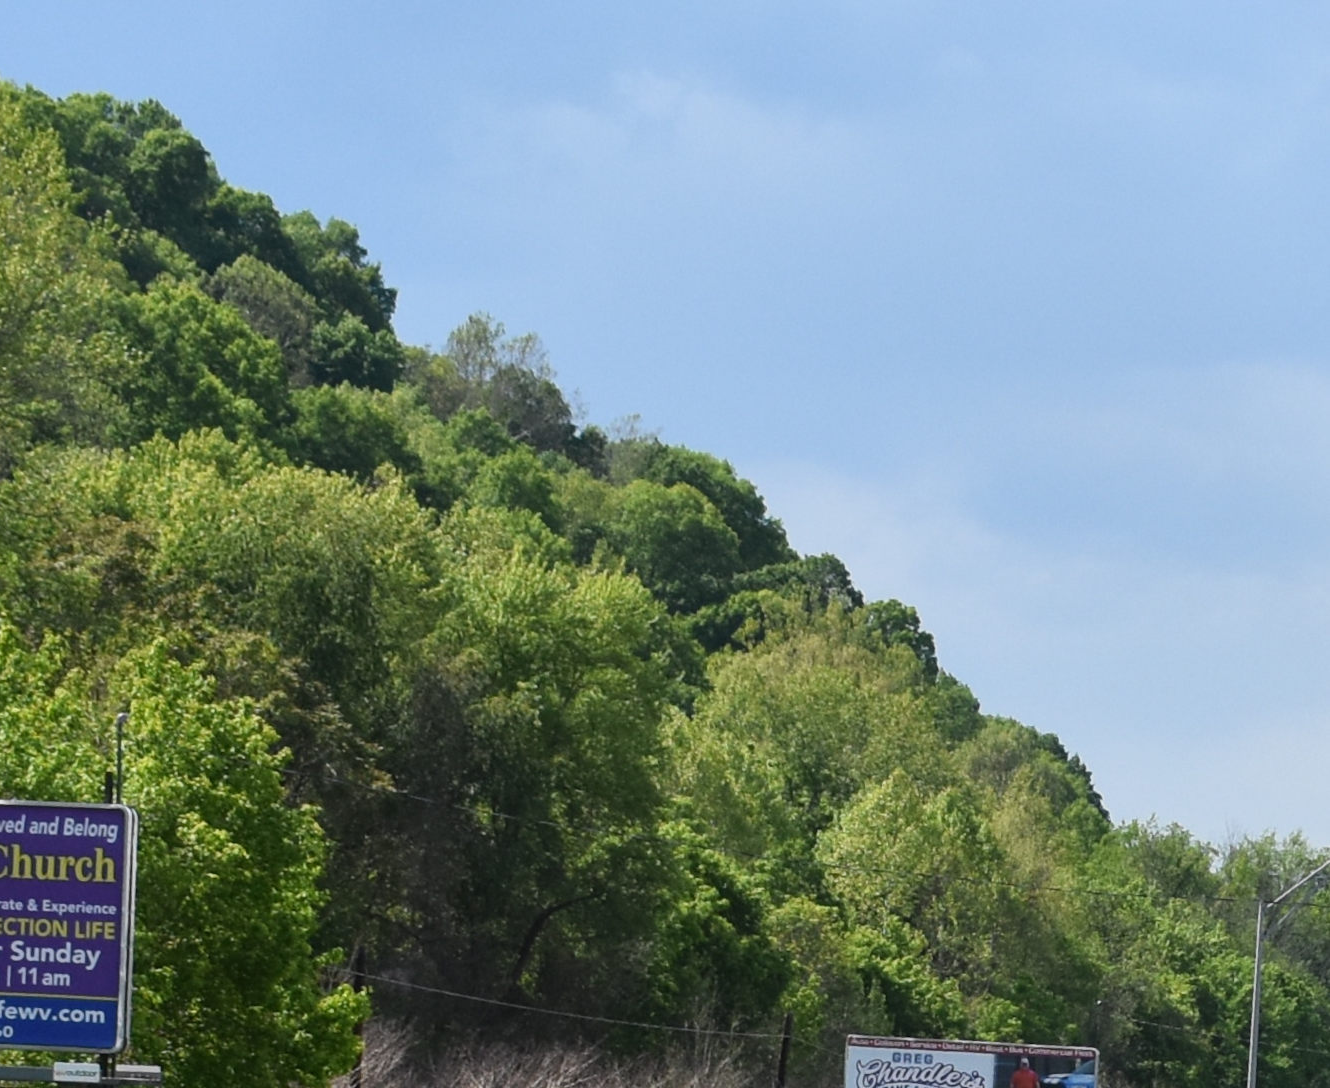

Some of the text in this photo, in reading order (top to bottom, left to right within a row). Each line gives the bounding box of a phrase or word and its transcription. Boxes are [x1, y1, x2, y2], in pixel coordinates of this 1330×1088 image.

[29, 816, 60, 836] and
[63, 817, 119, 844] Belong
[27, 898, 38, 912] &
[42, 900, 117, 916] Experience
[74, 920, 116, 940] LIFE
[10, 940, 101, 971] Sunday
[892, 1052, 934, 1065] GREG
